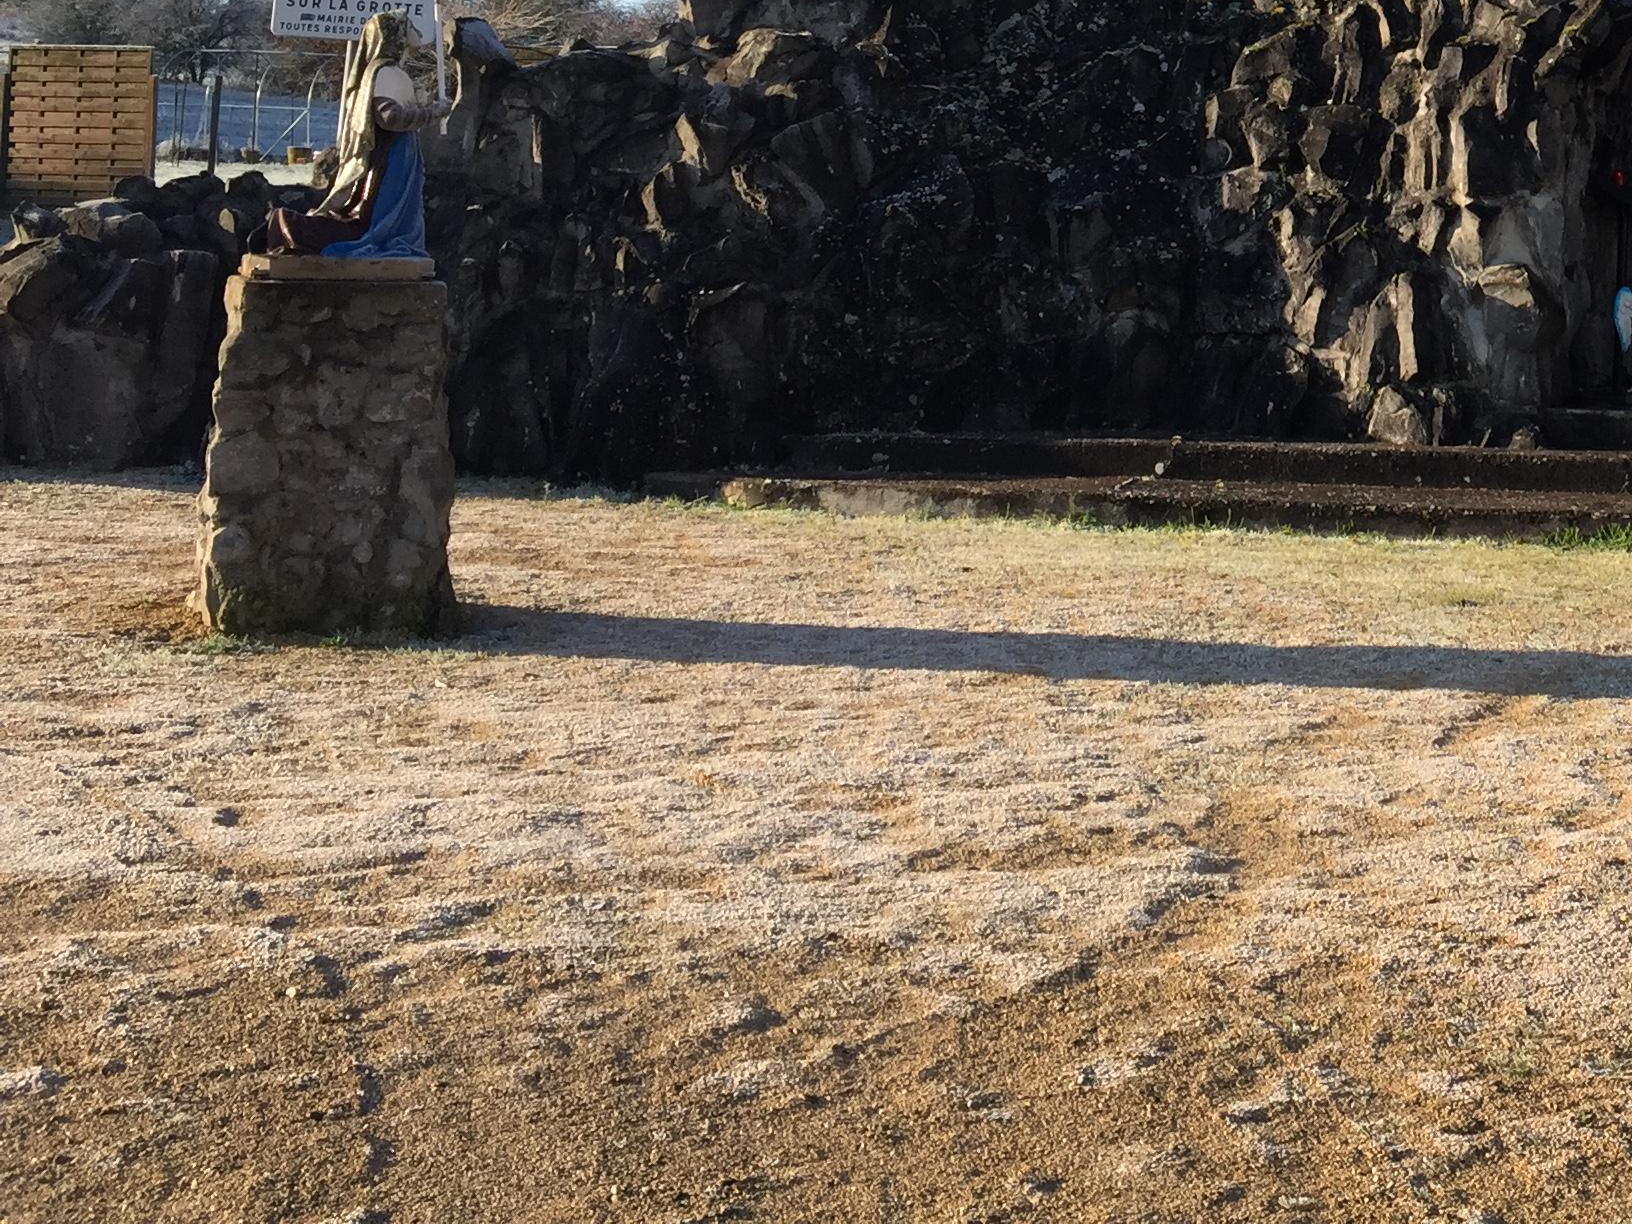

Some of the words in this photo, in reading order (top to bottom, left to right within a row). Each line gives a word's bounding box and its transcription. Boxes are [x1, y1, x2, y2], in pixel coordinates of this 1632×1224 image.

[356, 0, 424, 16] GROTTE
[317, 13, 356, 25] MAIRIE
[280, 21, 320, 33] TOUTES
[324, 24, 363, 35] RESPO
